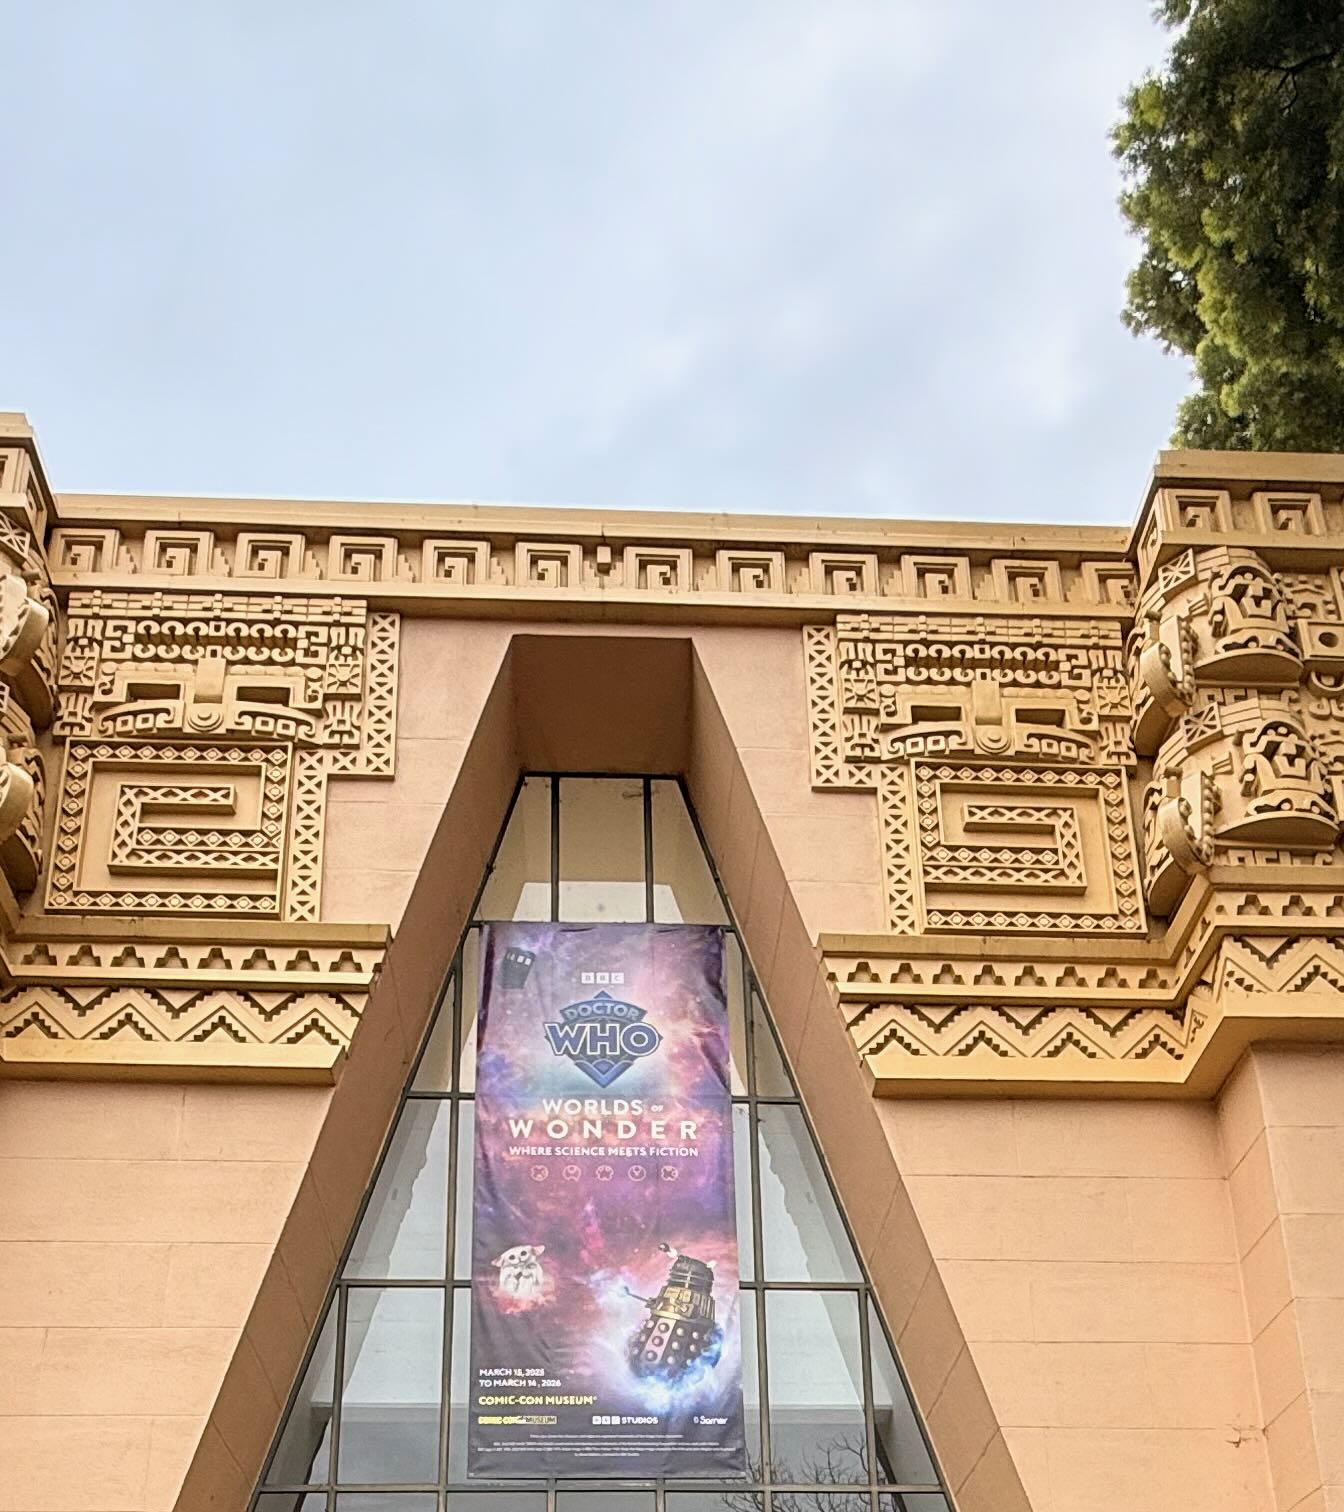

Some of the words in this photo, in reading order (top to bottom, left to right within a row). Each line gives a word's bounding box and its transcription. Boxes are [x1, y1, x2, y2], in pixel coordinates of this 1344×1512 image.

[564, 1002, 640, 1020] DOCTOR
[544, 1022, 660, 1056] WHO
[543, 1099, 643, 1115] WORLDS
[509, 1120, 697, 1139] WONDER
[509, 1147, 552, 1156] WHERE
[555, 1147, 605, 1156] SCIENCE
[608, 1147, 647, 1157] MEETS
[649, 1147, 698, 1157] FICTION
[479, 1368, 512, 1377] MARCH
[479, 1379, 492, 1387] TO
[494, 1379, 526, 1387] MARCH
[478, 1396, 543, 1405] COMIC-CON
